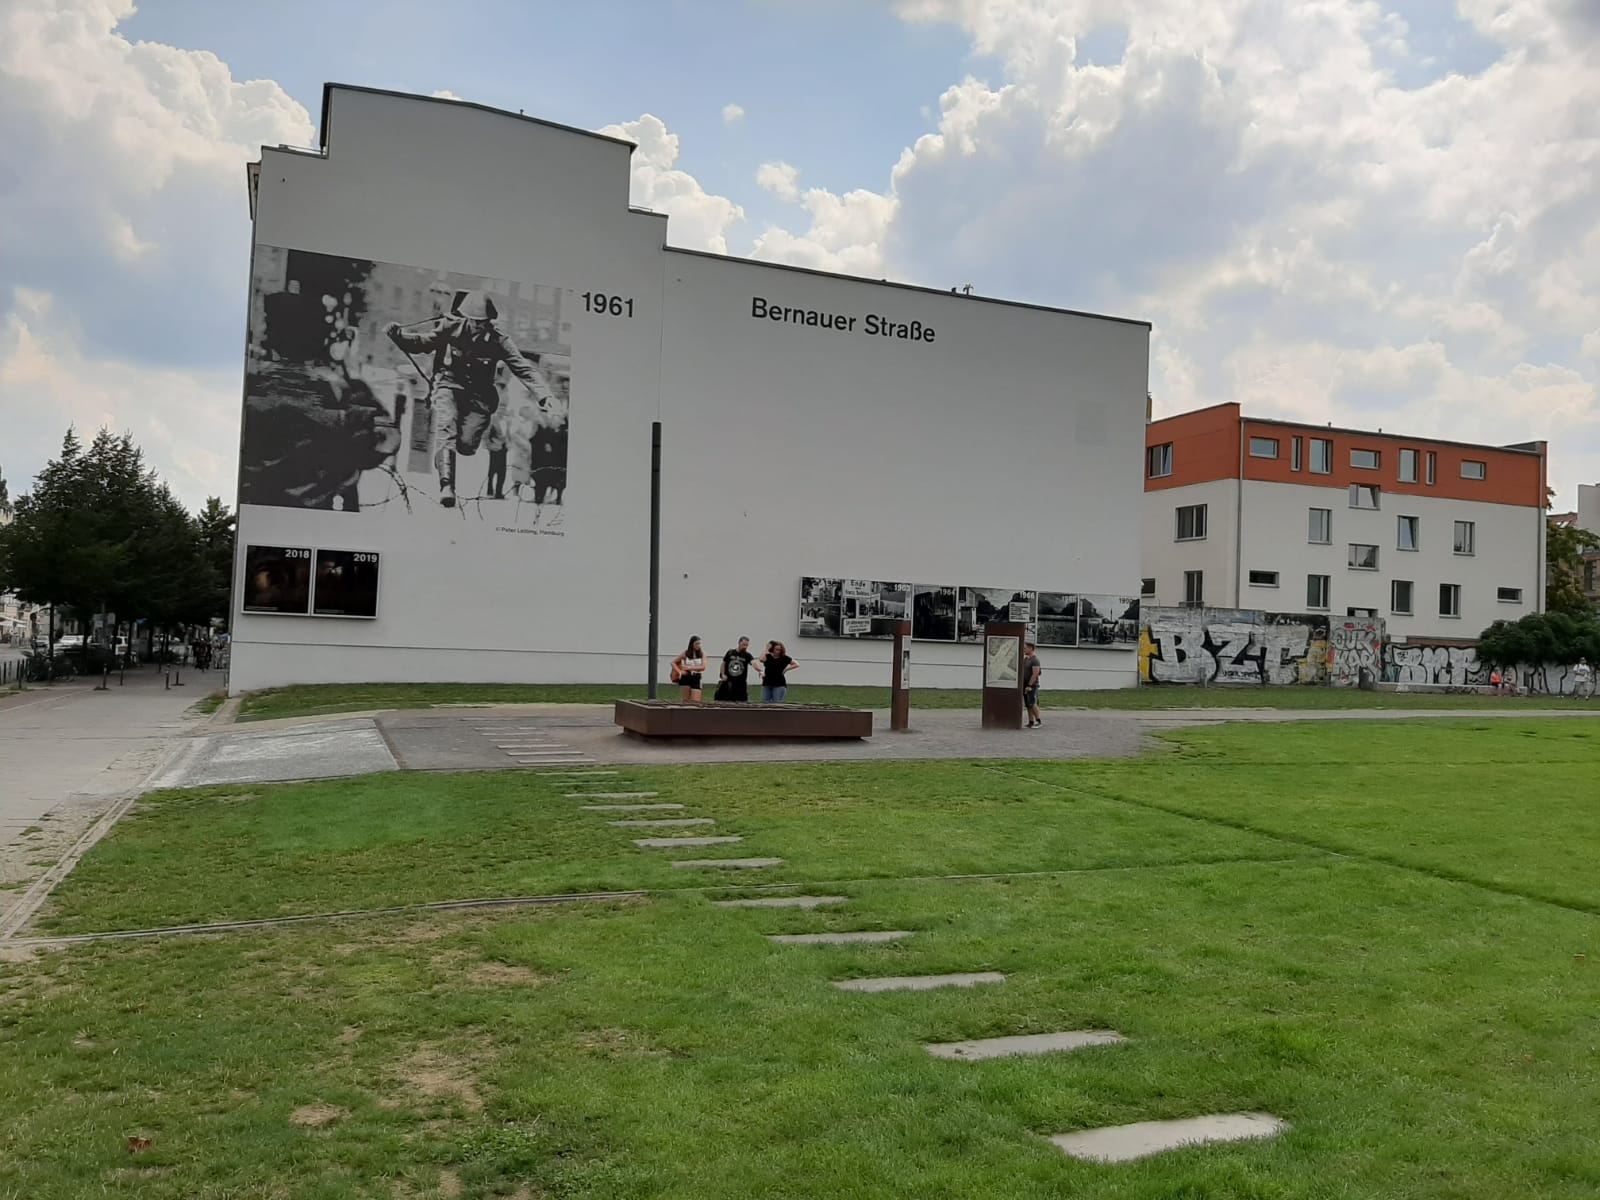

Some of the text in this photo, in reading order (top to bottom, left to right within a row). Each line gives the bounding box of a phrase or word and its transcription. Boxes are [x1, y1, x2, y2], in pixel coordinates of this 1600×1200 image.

[581, 291, 635, 318] 1961
[752, 297, 936, 343] Bernauer Straße
[285, 548, 310, 559] 2018
[353, 553, 378, 563] 2019
